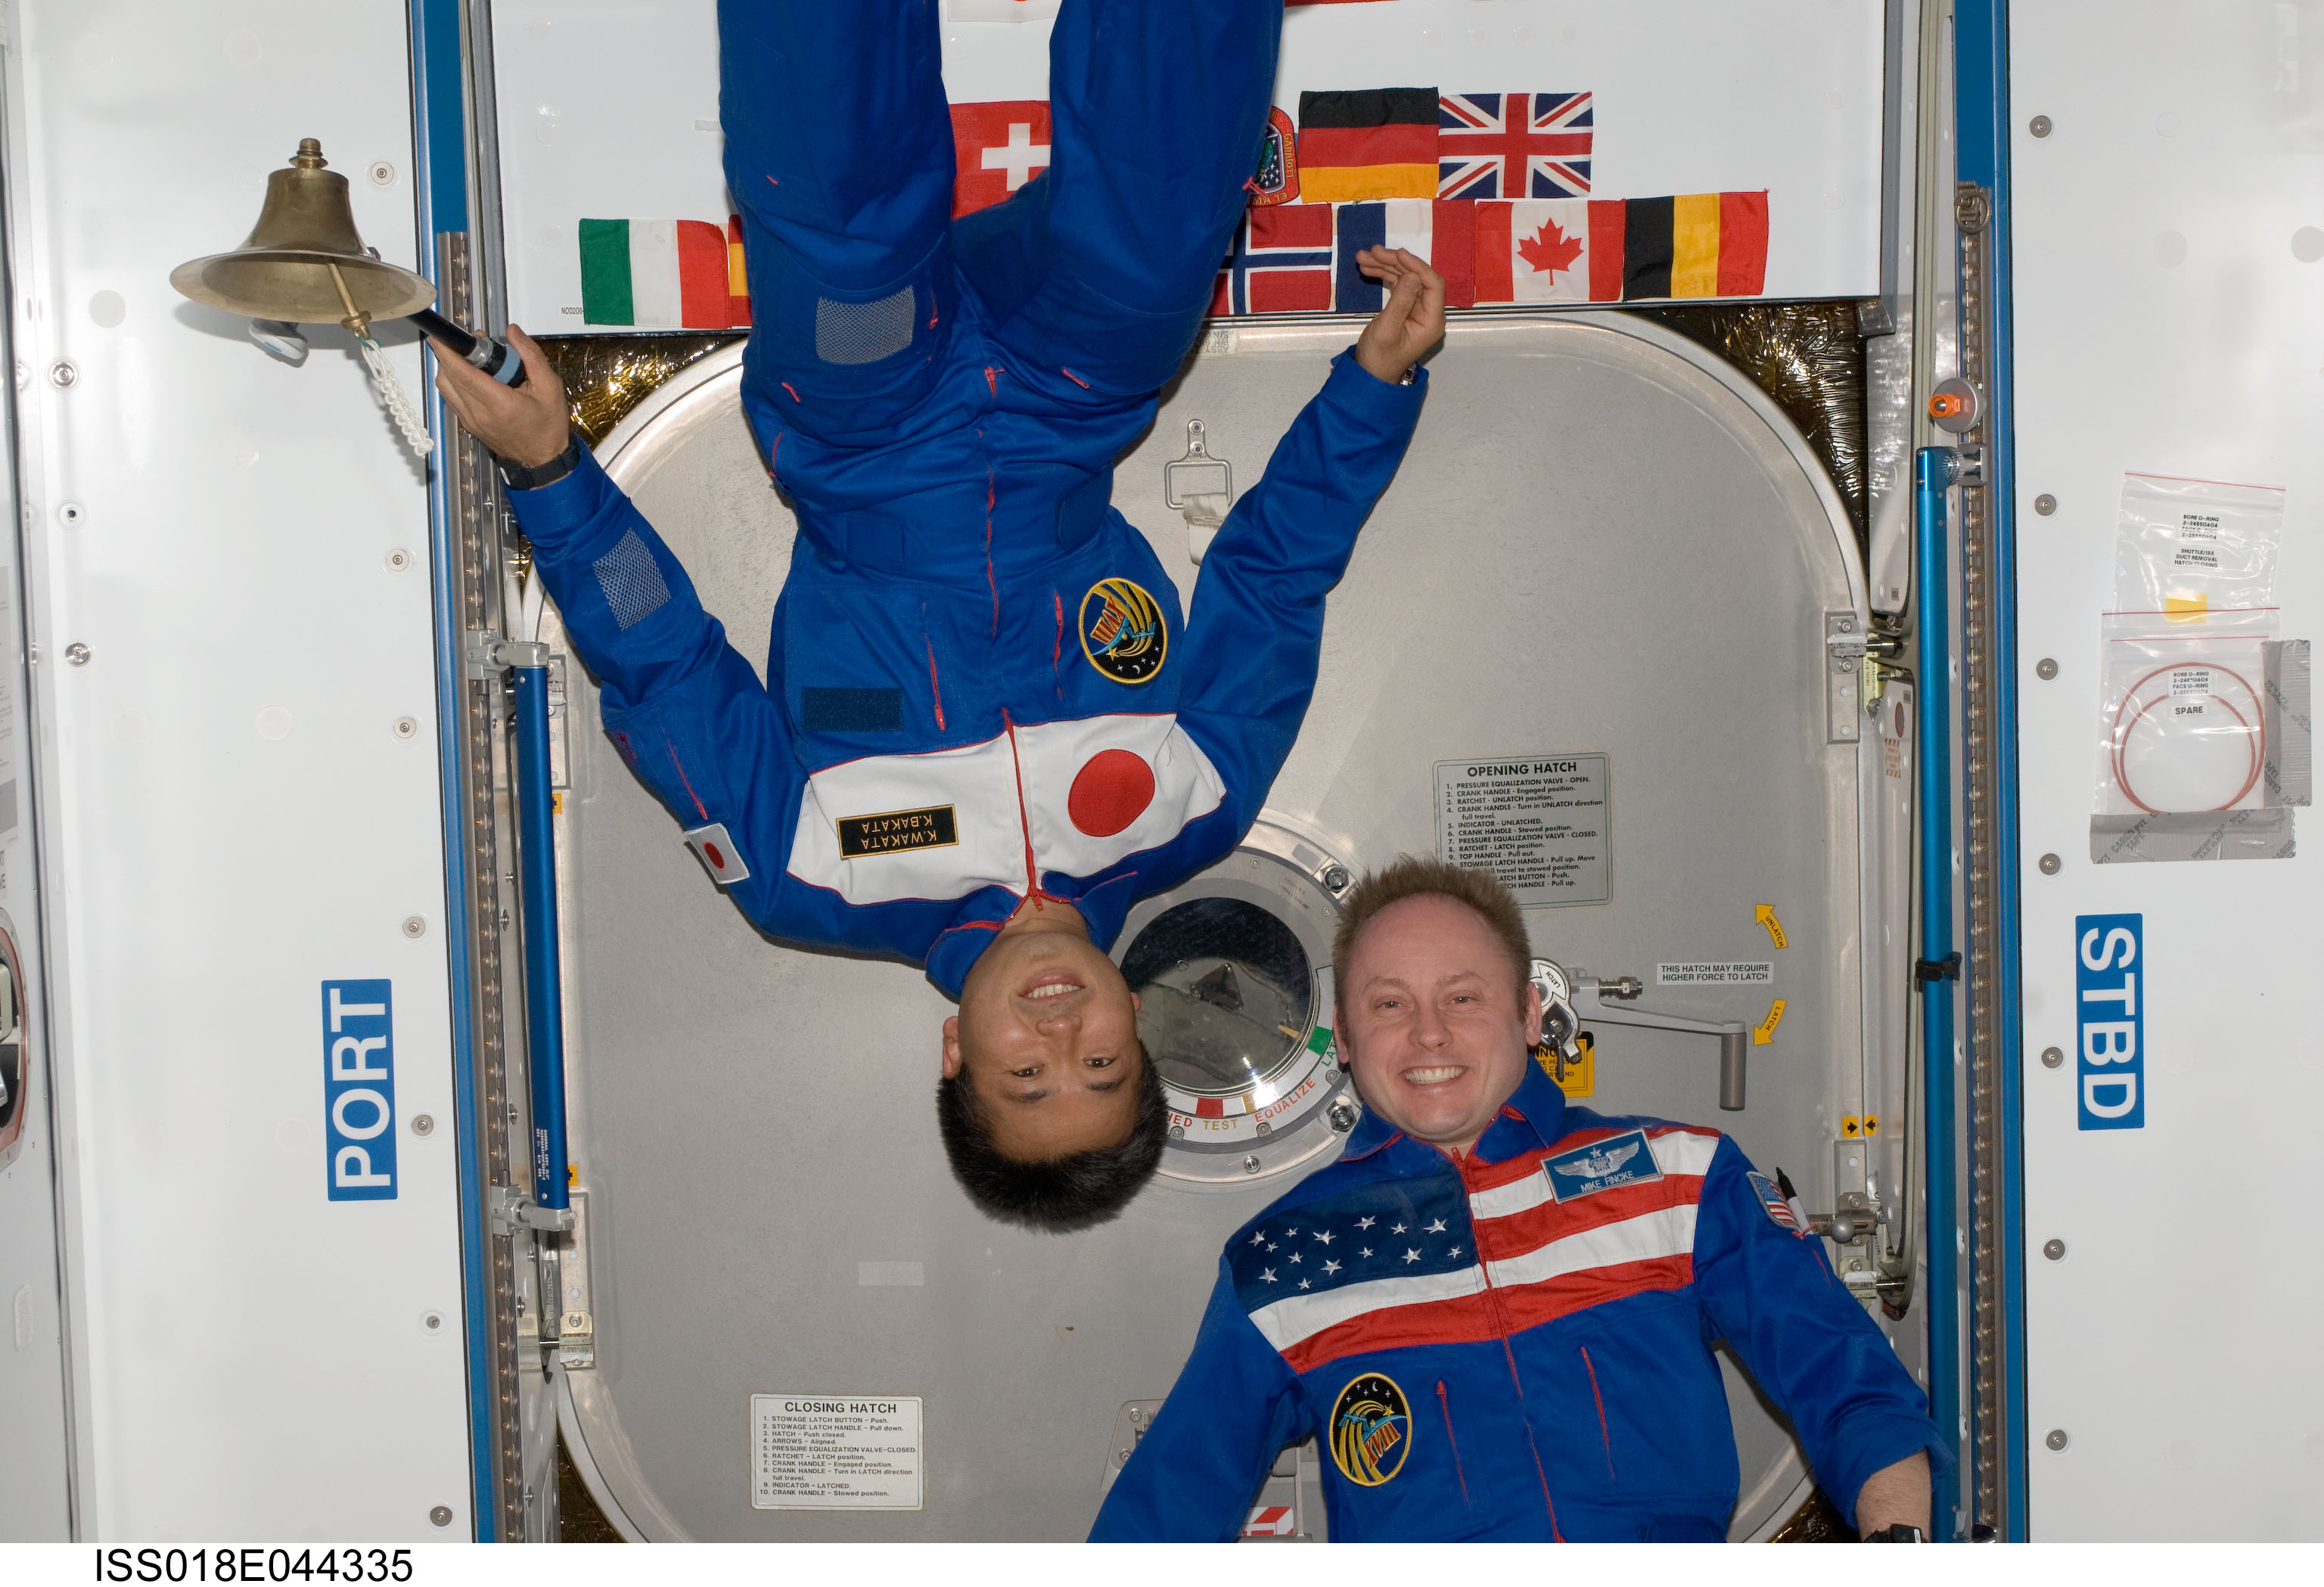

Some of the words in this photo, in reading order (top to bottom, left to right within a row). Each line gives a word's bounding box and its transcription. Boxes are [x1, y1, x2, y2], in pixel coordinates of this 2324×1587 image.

[1253, 196, 1271, 204] MA
[1275, 192, 1287, 201] 13
[2175, 706, 2203, 715] SPARE
[1468, 765, 1528, 777] OPENING
[1534, 762, 1577, 773] HATCH
[861, 830, 937, 849] K.WAKATA
[2111, 829, 2135, 853] CARGO
[2134, 818, 2147, 831] PIT
[2126, 831, 2145, 850] TAPE
[2272, 840, 2294, 859] ARGO
[1765, 915, 1784, 947] UNLATCH
[1546, 971, 1561, 989] LATCH
[1766, 1007, 1781, 1030] LATCH
[2081, 927, 2136, 1118] STBD
[330, 988, 390, 1188] PORT
[1202, 1119, 1238, 1131] TEST
[1254, 1077, 1316, 1123] EQUALIZE
[1580, 1179, 1601, 1192] MIKE
[1605, 1171, 1634, 1186] FINCKE
[785, 1402, 844, 1412] CLOSING
[850, 1404, 896, 1413] HATCH
